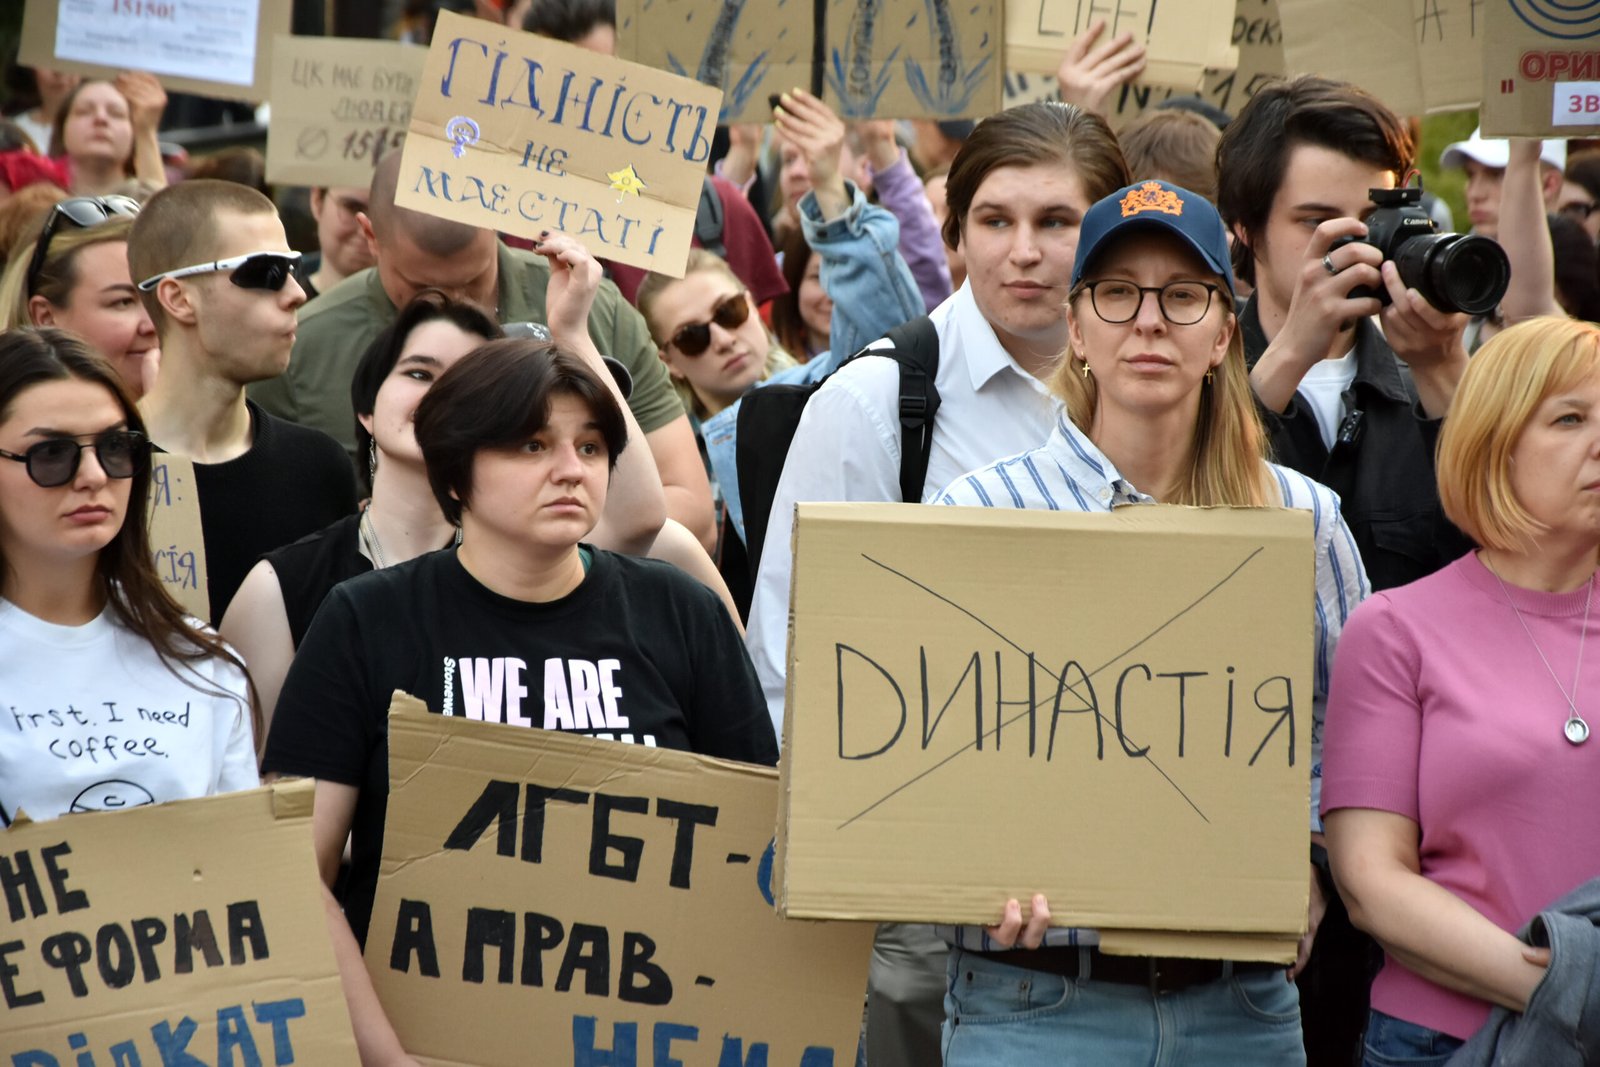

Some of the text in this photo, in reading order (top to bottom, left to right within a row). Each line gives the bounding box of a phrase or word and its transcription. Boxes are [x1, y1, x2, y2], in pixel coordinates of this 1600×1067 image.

[440, 37, 710, 163] ГІДНІСТЬ
[517, 140, 570, 177] НЕ
[102, 701, 124, 723] I
[136, 701, 190, 729] need
[458, 656, 630, 730] WE ARE
[48, 734, 169, 764] coffee.
[0, 841, 90, 923] НЕ
[389, 898, 441, 979] А
